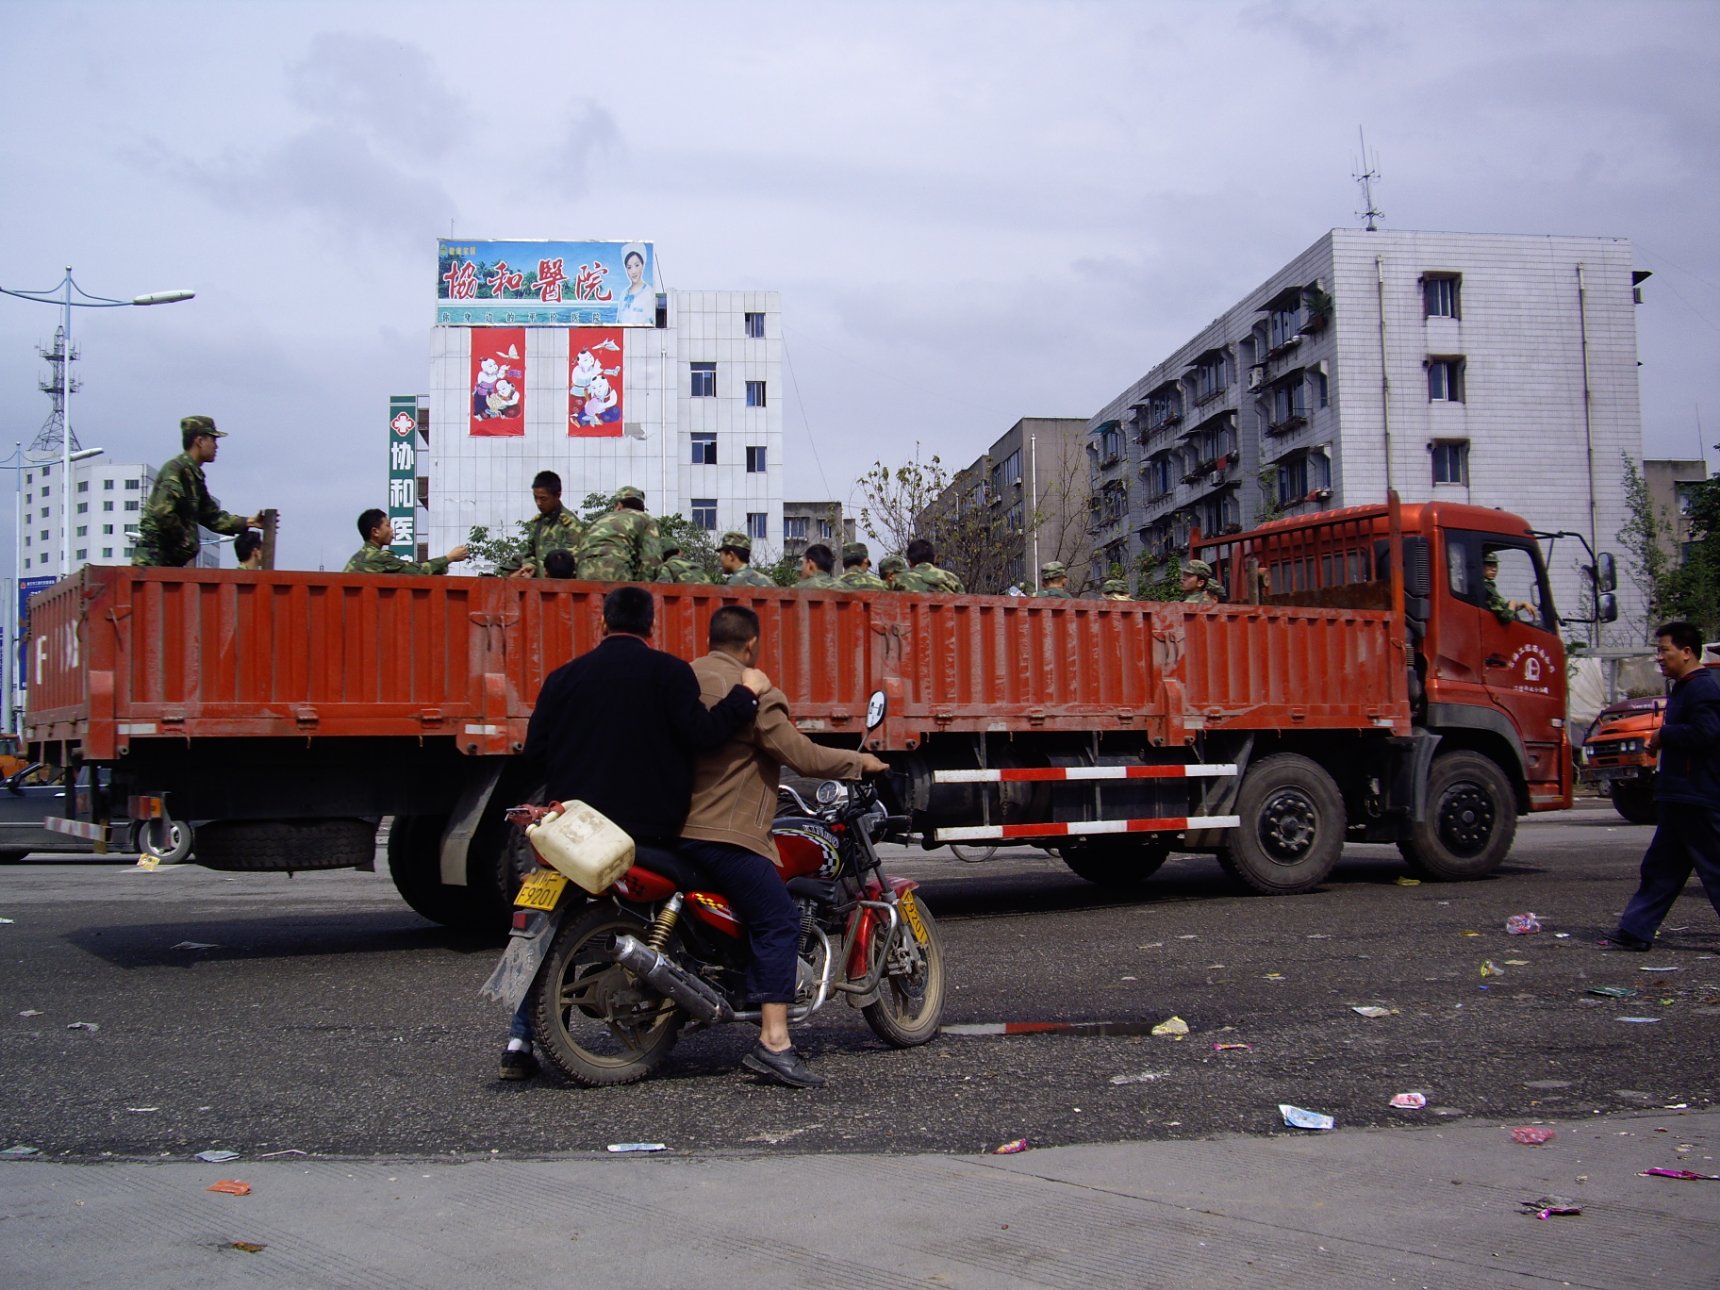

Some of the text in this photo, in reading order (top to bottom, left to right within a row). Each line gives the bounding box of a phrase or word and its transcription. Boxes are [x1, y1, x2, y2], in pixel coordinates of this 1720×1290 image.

[443, 257, 613, 303] 協和醫院
[516, 886, 558, 908] F9201
